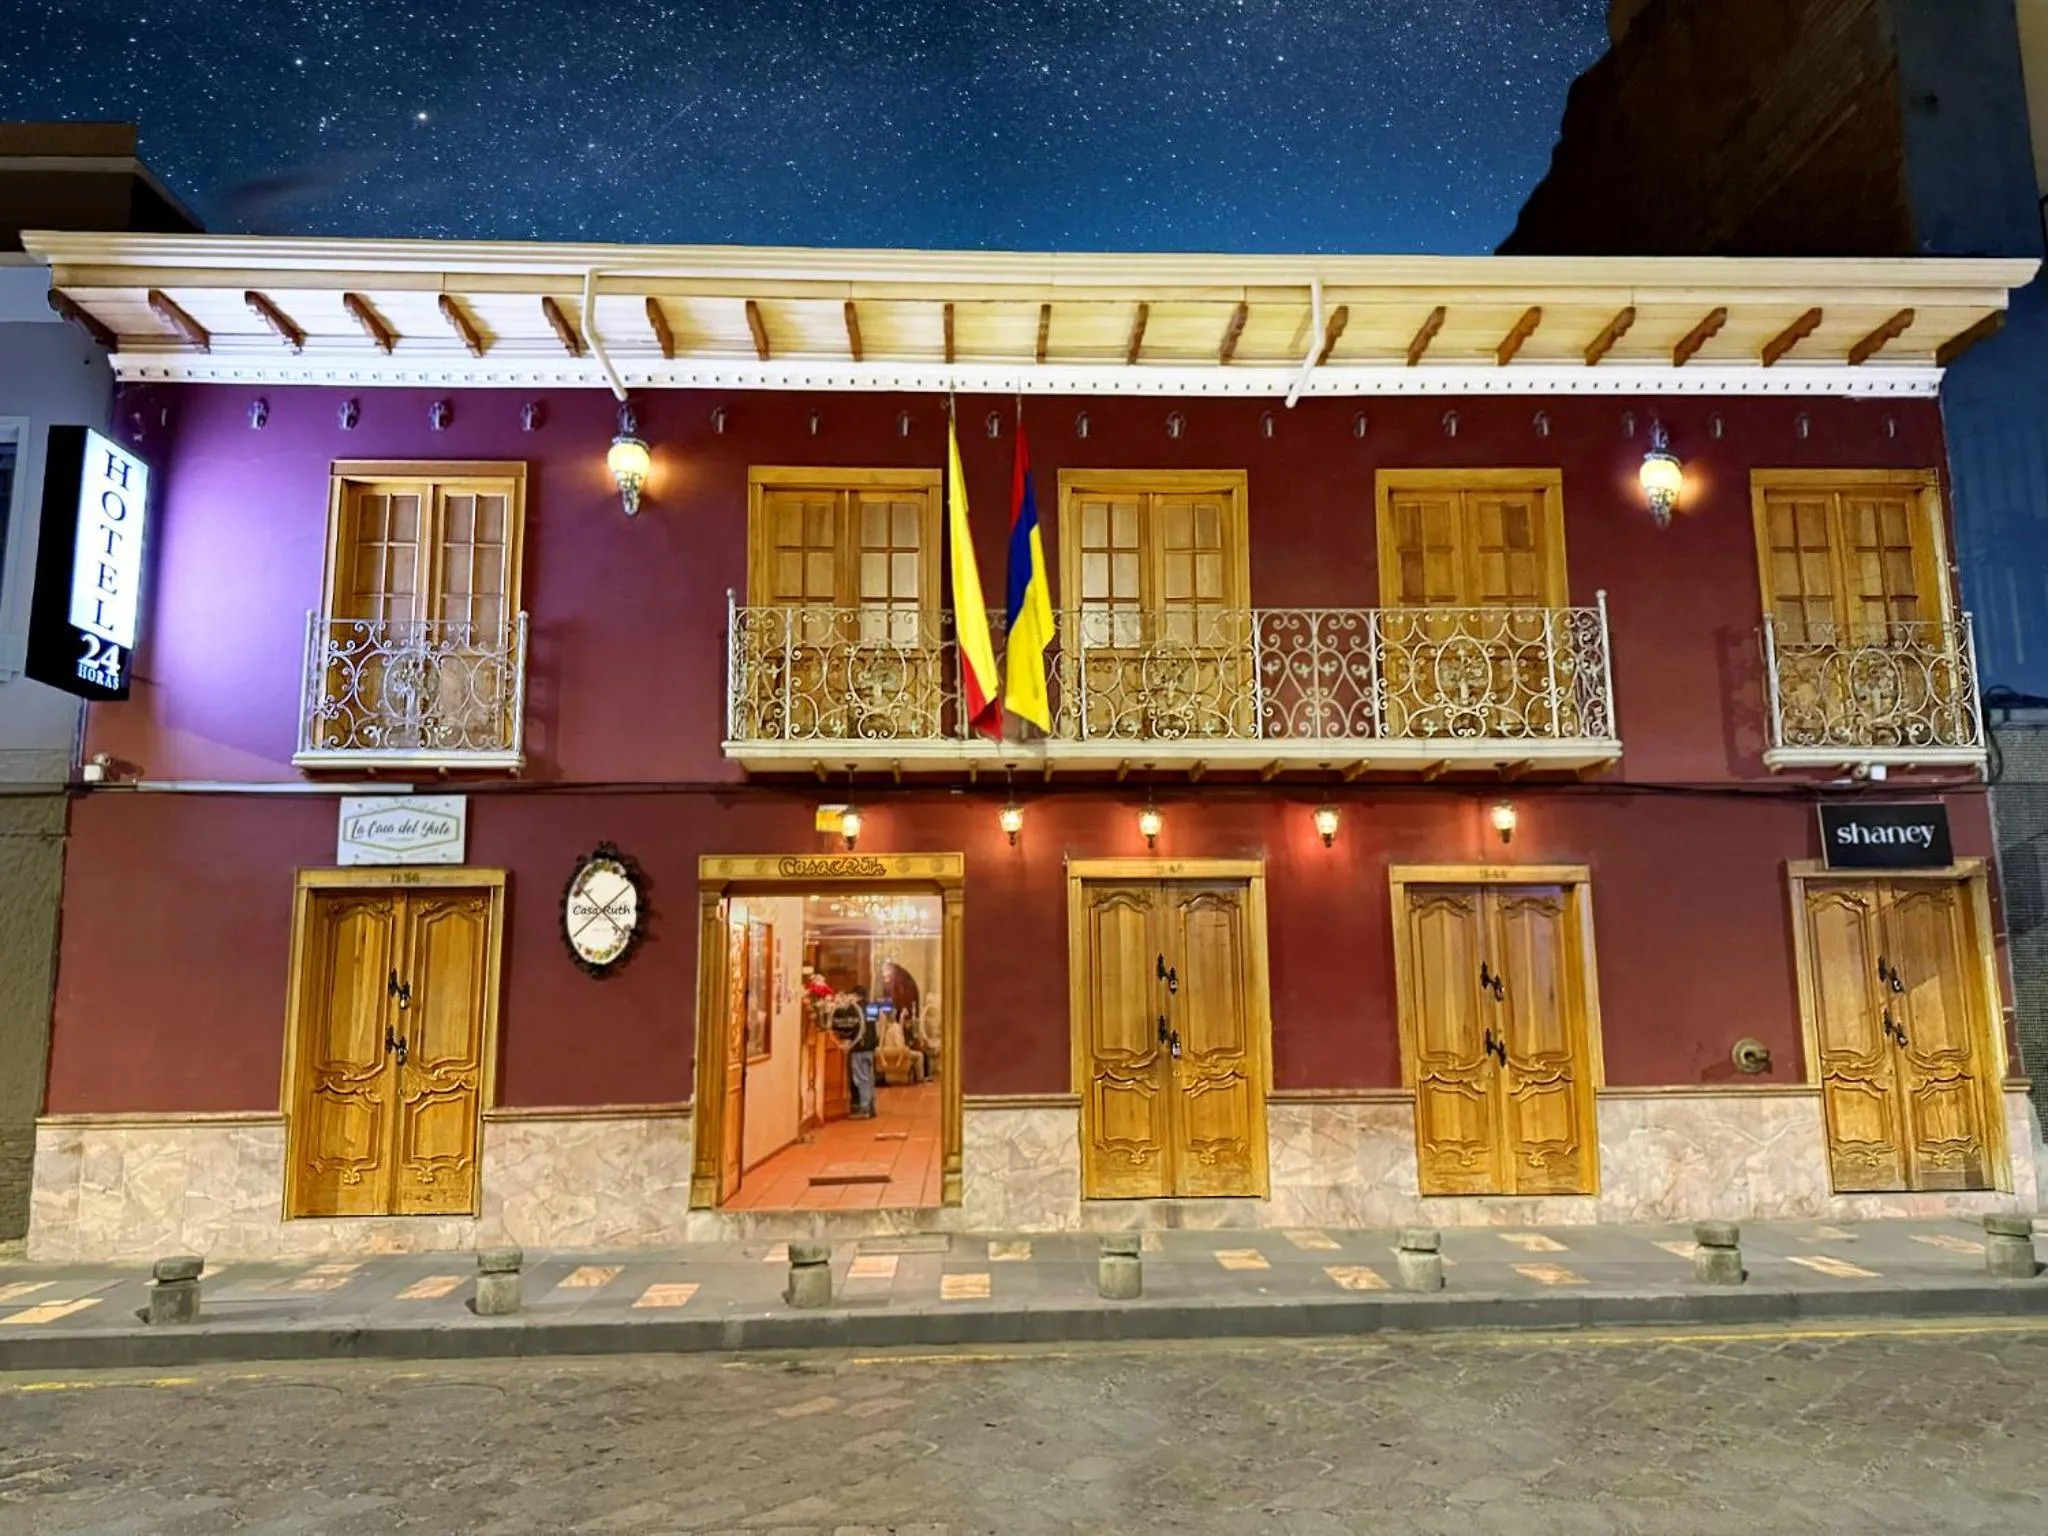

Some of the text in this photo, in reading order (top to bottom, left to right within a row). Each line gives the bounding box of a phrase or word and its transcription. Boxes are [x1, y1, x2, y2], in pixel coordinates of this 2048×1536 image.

[93, 449, 133, 632] HOTEL
[78, 633, 121, 677] 24
[77, 663, 119, 690] HORAS
[351, 818, 364, 840] La
[367, 819, 394, 837] Casa
[397, 818, 420, 835] del
[1836, 822, 1936, 848] shaney
[572, 904, 631, 916] Casa Ruth
